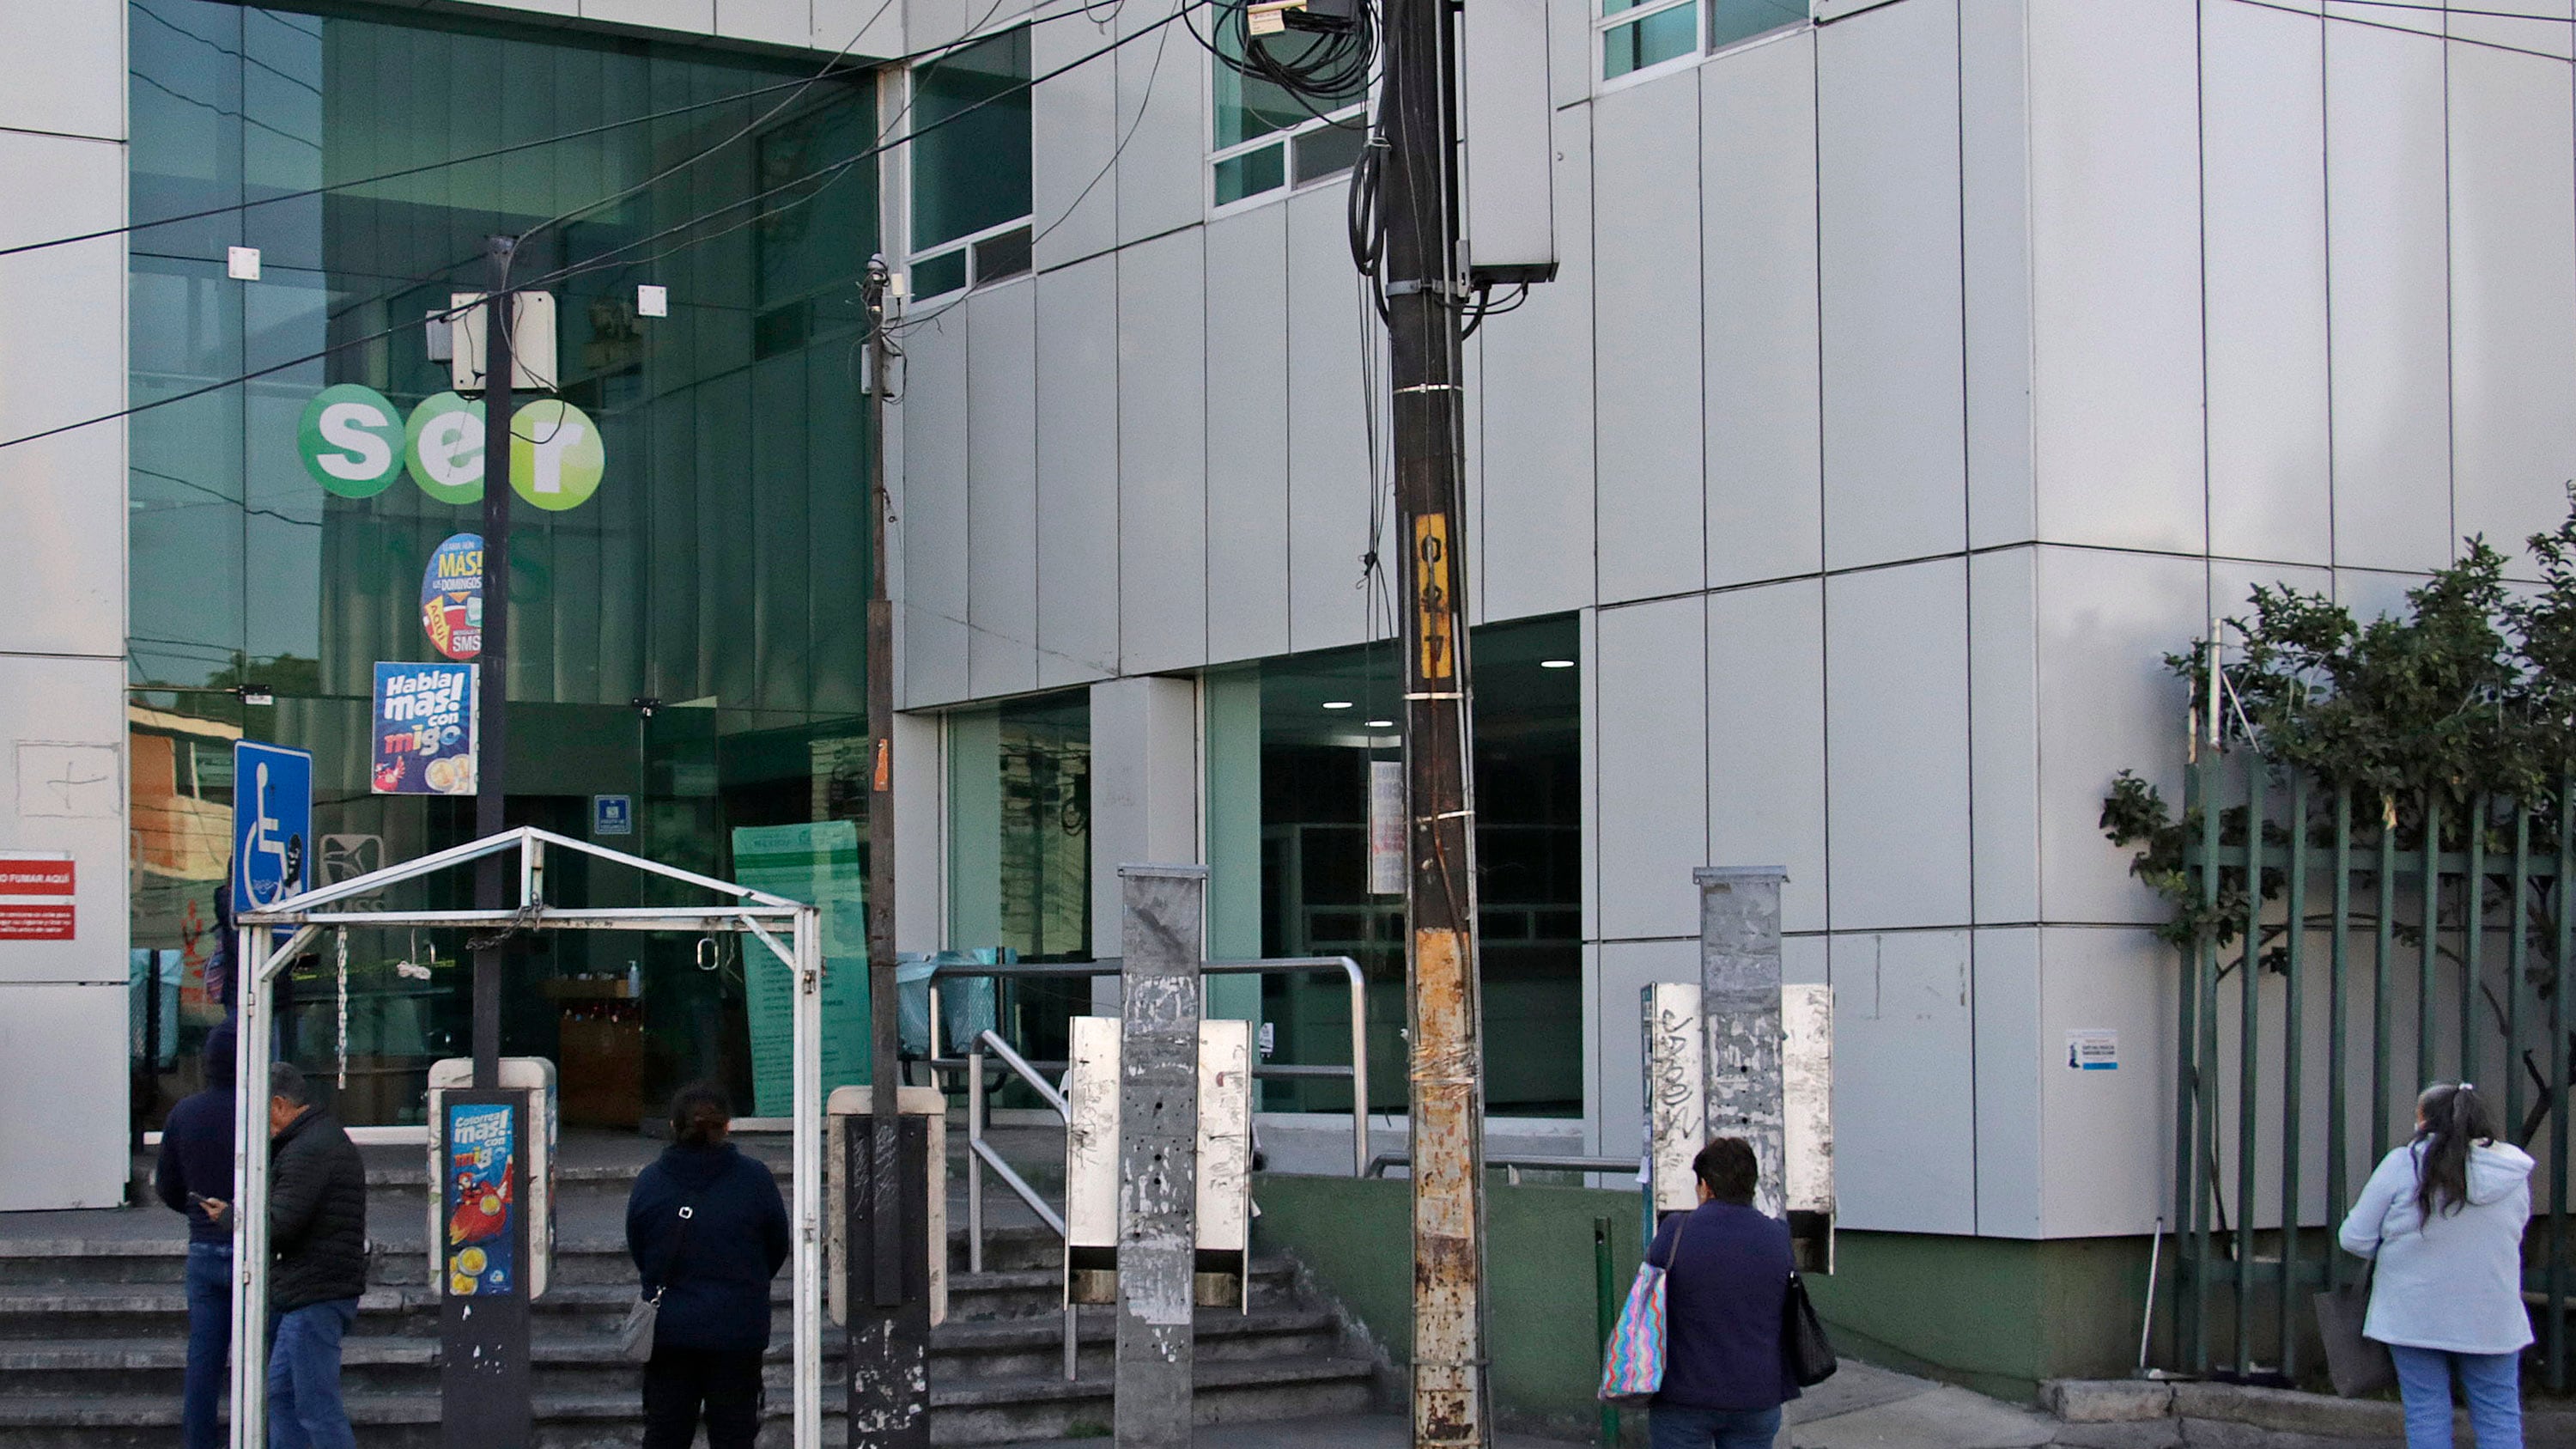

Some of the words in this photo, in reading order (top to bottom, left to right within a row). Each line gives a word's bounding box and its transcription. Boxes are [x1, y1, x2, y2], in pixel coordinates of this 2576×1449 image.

[317, 403, 585, 493] ser
[441, 576, 482, 591] DOMINGOS
[453, 635, 482, 652] SMS
[386, 670, 452, 697] Habla
[384, 673, 465, 721] mas!
[428, 712, 459, 727] con
[384, 724, 461, 756] migo
[9, 874, 44, 884] FUMAR
[454, 1109, 508, 1144] mas!
[484, 1137, 506, 1148] con
[455, 1146, 506, 1169] migo
